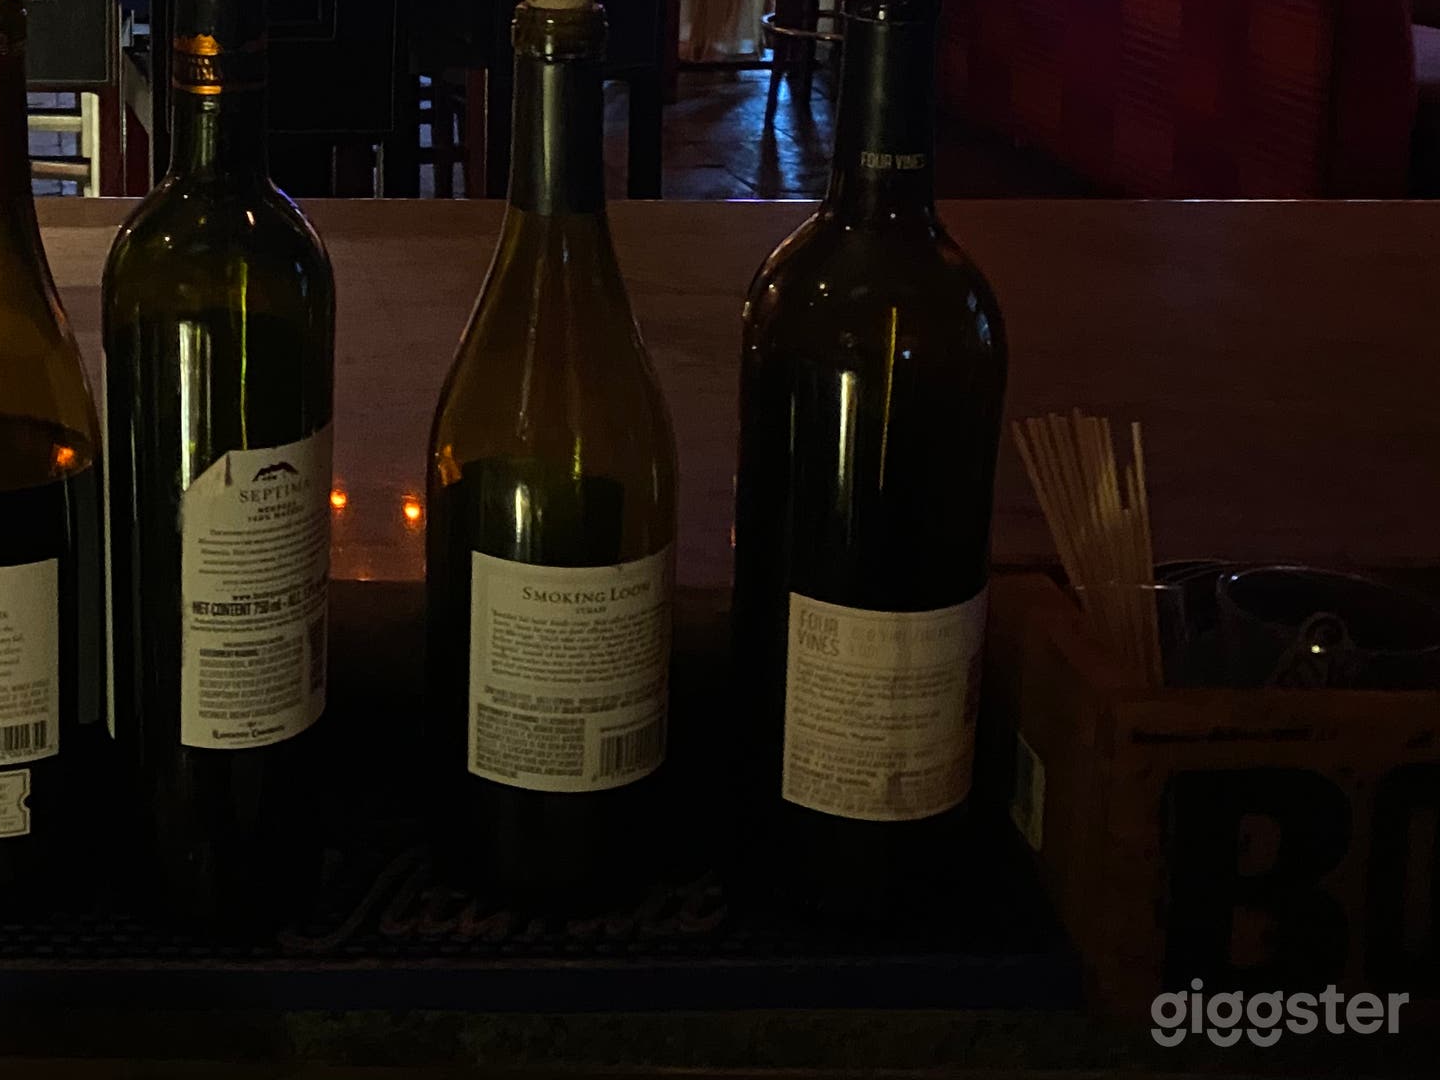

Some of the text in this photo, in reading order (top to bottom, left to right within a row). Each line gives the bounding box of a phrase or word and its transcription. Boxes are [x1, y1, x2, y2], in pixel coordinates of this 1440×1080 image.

[522, 586, 606, 604] SMOKING
[799, 610, 840, 637] FOUR
[797, 628, 840, 656] VINES
